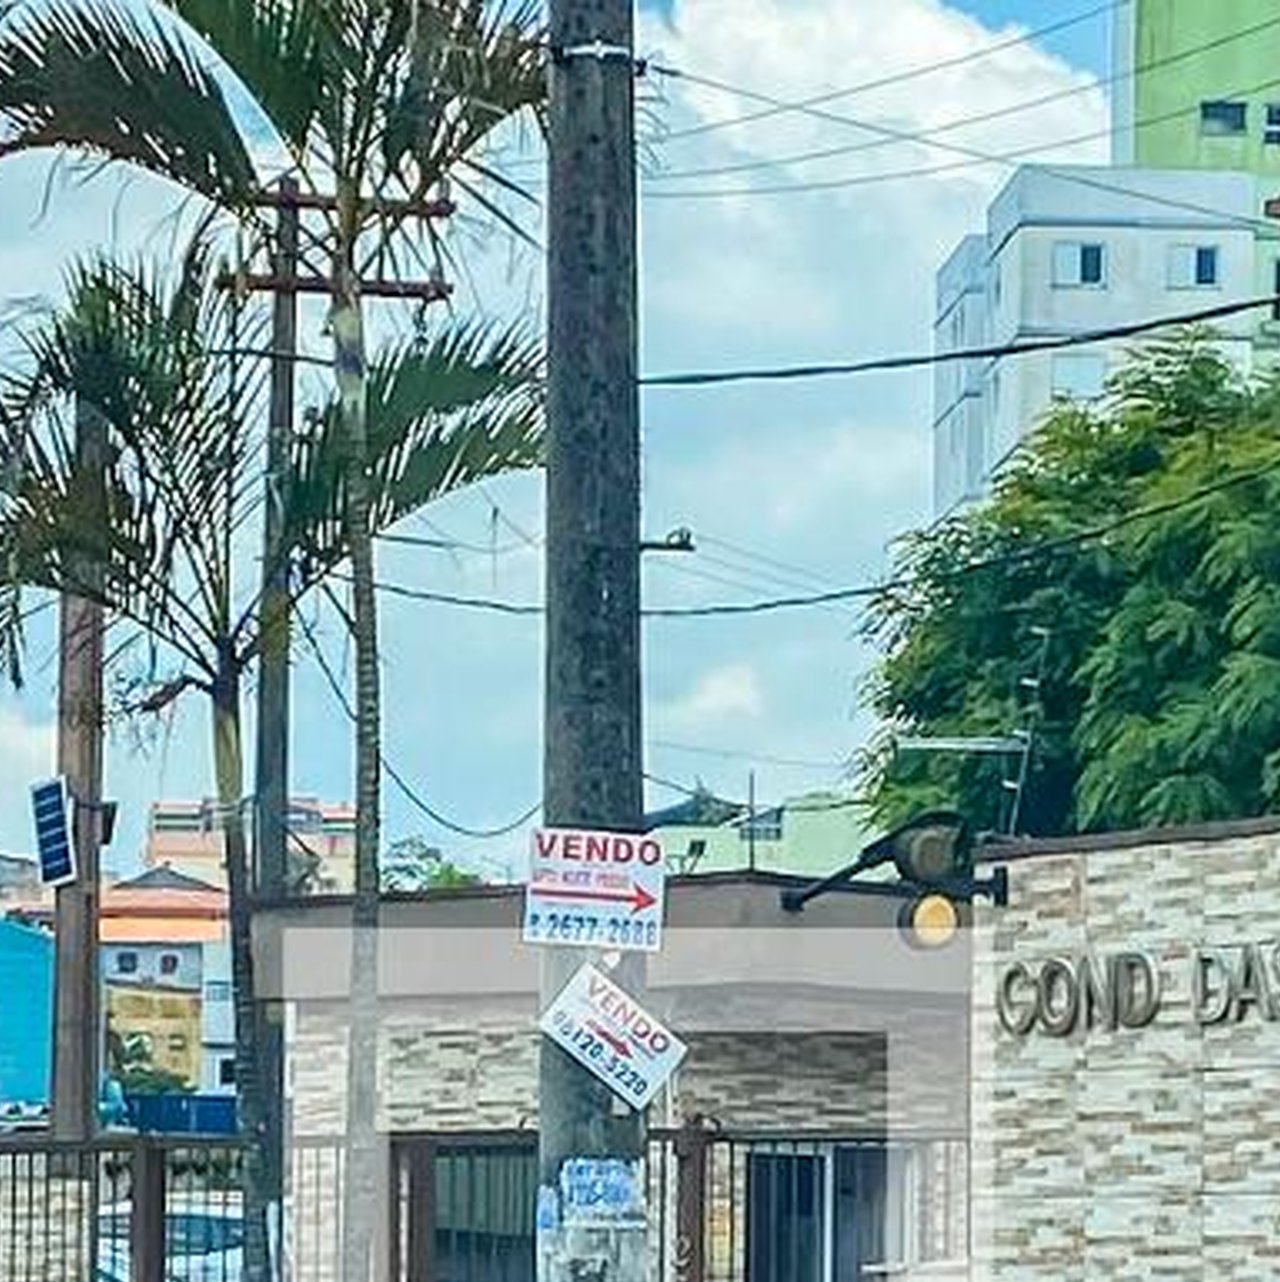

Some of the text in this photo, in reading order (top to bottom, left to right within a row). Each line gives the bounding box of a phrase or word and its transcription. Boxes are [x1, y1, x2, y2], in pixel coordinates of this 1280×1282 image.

[536, 834, 662, 866] VENDO
[586, 975, 670, 1054] VENDO
[998, 950, 1161, 1037] COND
